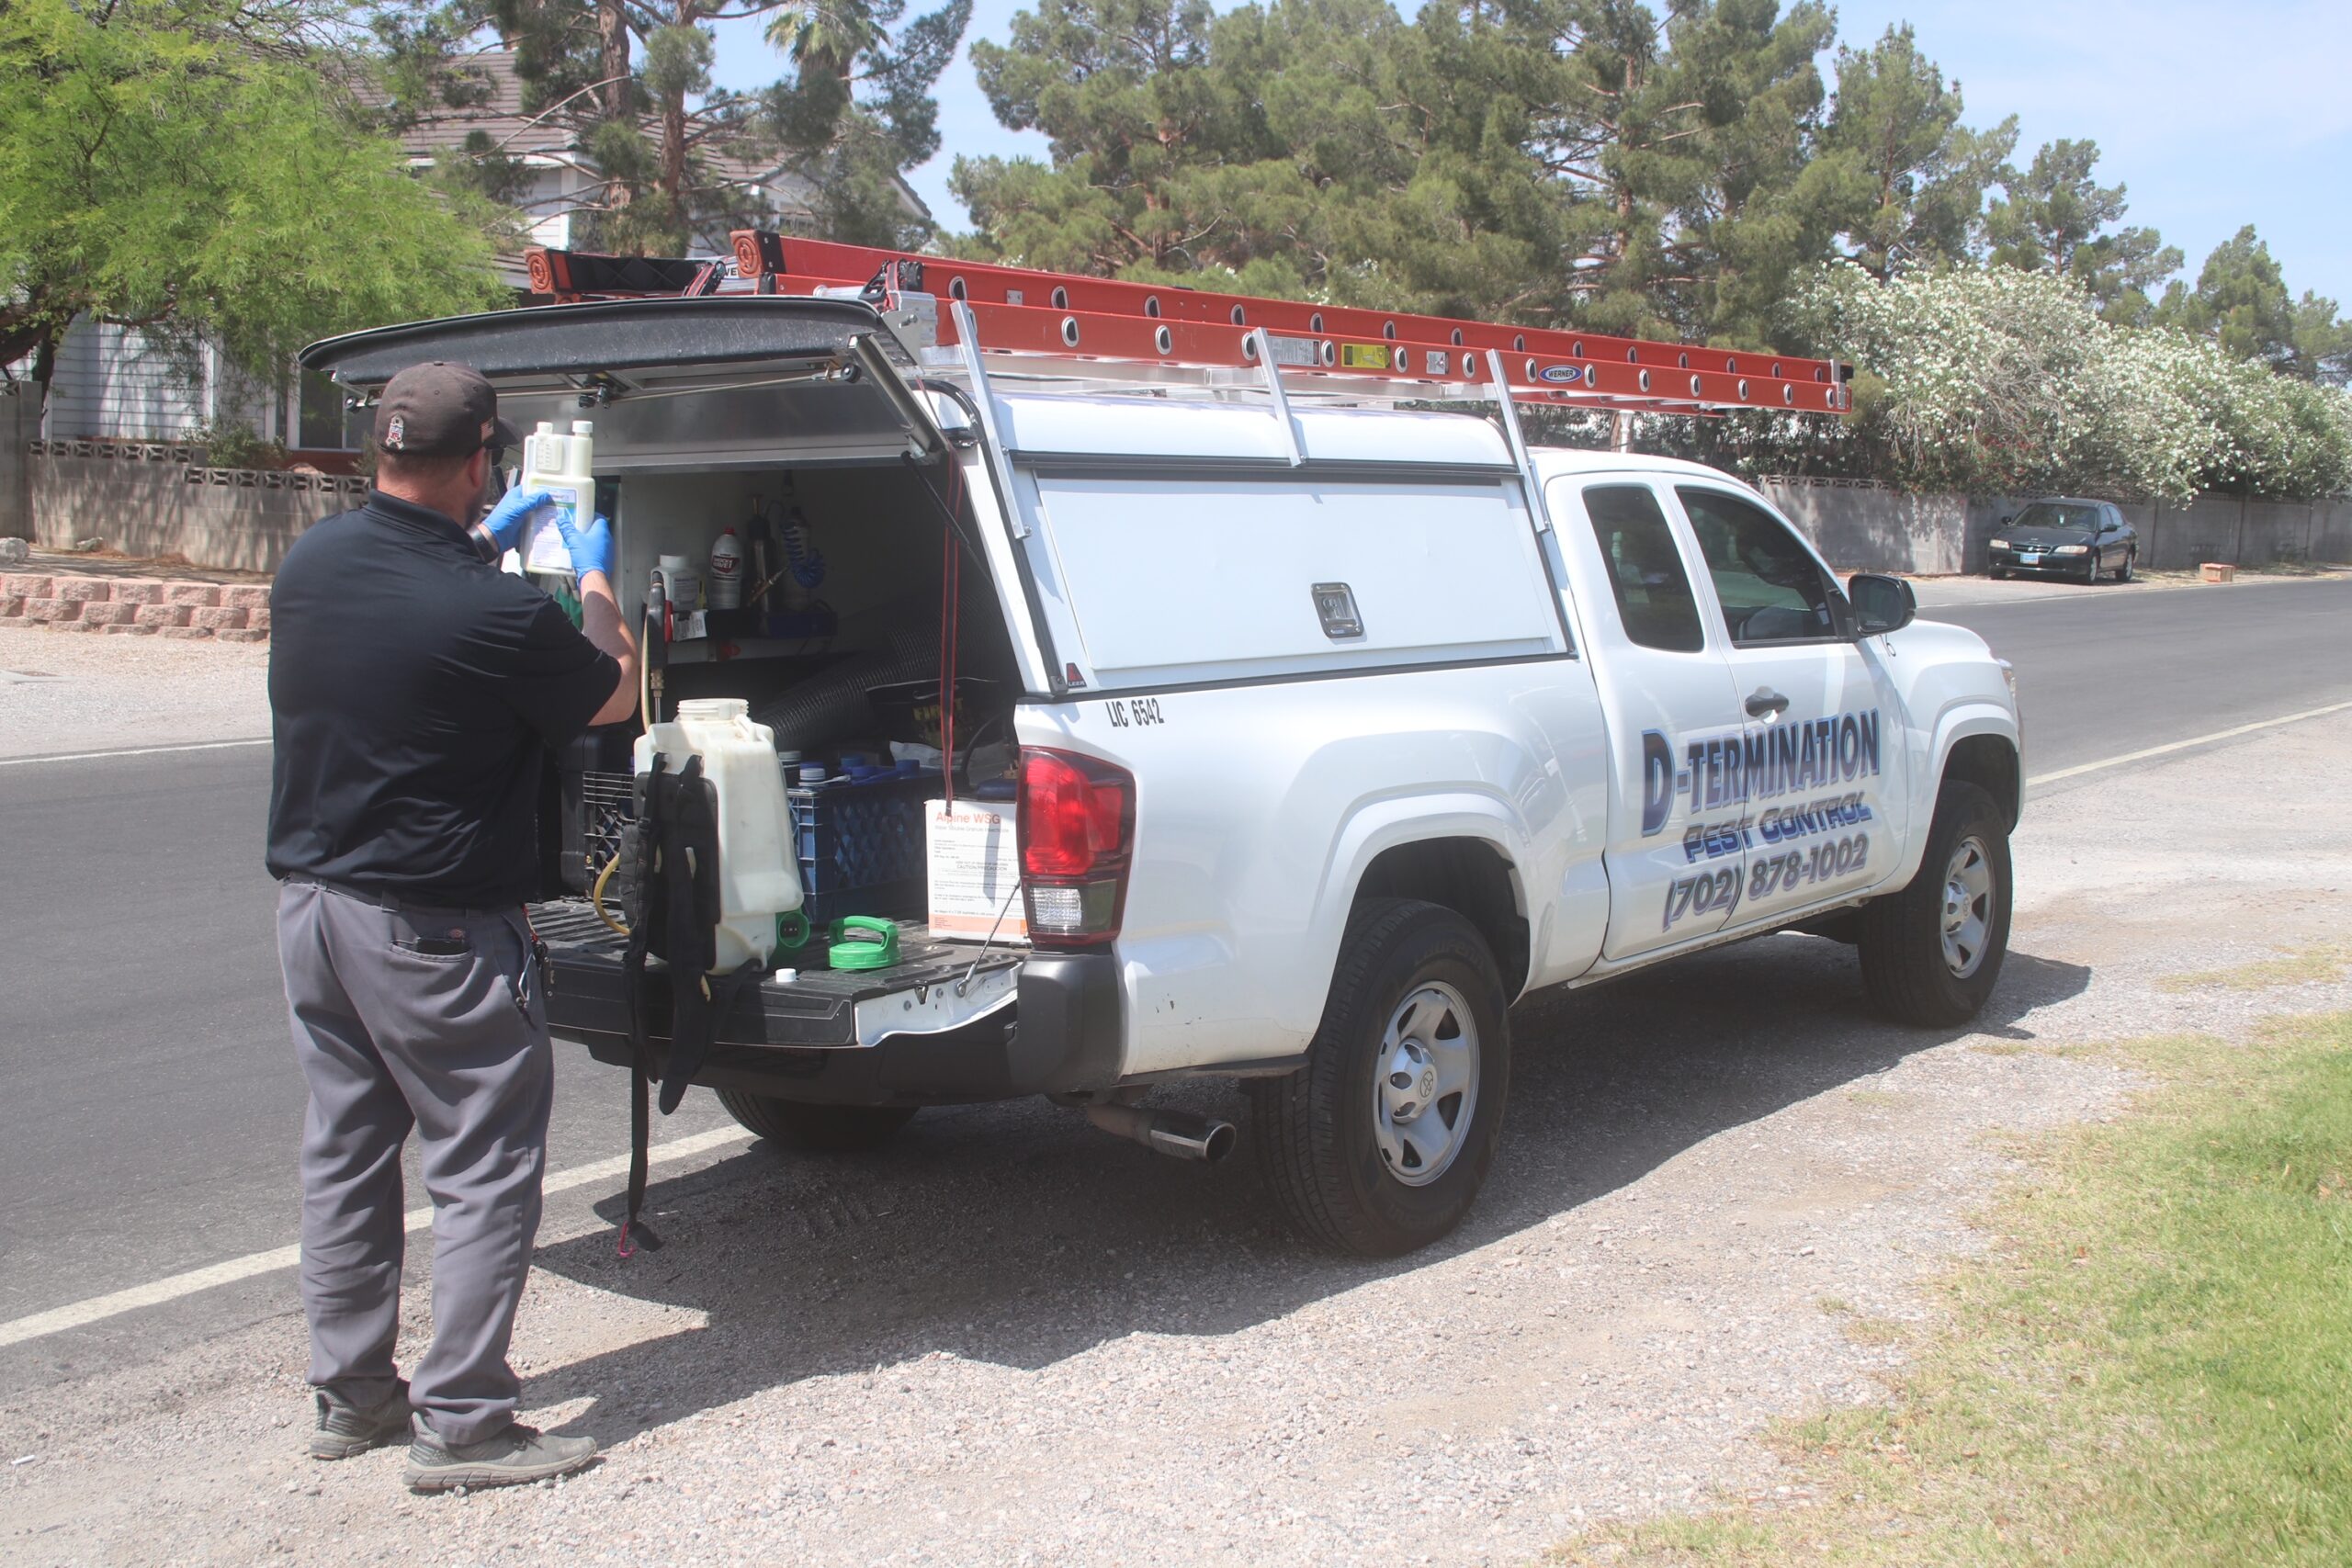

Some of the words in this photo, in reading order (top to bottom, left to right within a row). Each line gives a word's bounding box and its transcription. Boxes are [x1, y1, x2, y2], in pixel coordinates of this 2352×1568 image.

[1548, 369, 1574, 378] WERNER
[1105, 701, 1128, 728] LIC
[1131, 698, 1165, 726] 6542
[1641, 707, 1882, 838] D-TERMINATION
[935, 811, 970, 825] Alpine
[973, 813, 1001, 825] WSG
[1682, 817, 1756, 863] PEST
[1758, 790, 1872, 844] CONTROL
[1661, 863, 1743, 932] (702)
[1748, 831, 1870, 902] 878-1002
